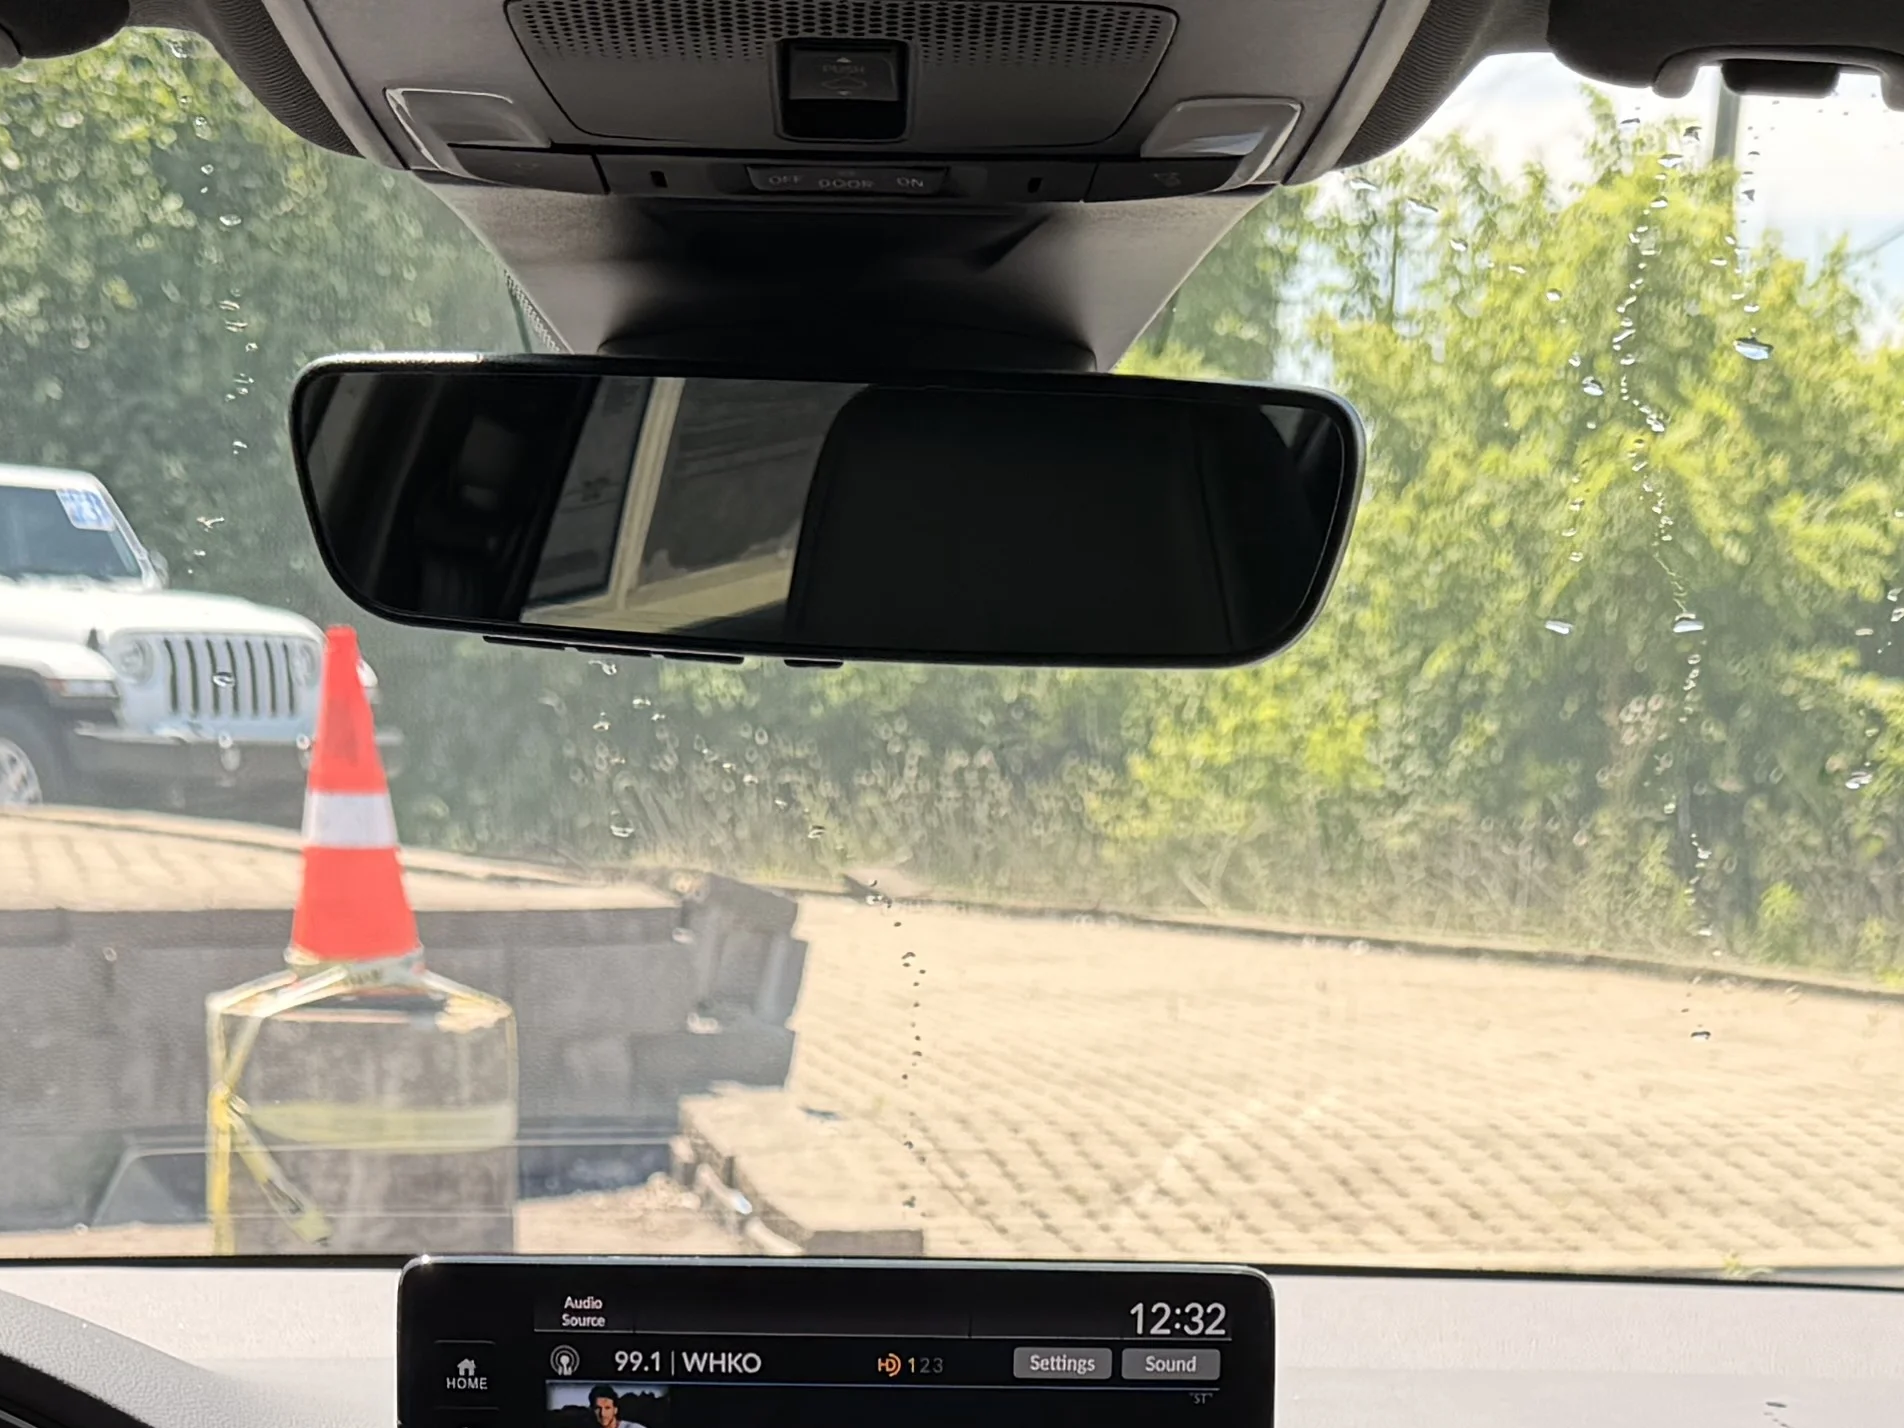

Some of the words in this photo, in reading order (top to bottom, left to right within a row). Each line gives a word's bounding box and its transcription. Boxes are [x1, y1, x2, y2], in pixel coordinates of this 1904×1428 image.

[768, 174, 804, 186] OFF
[817, 177, 876, 190] DOOR
[896, 176, 925, 189] ON
[564, 1296, 603, 1310] Audio
[561, 1313, 606, 1328] Source
[1130, 1302, 1227, 1336] 12:32
[614, 1351, 662, 1372] 99.1
[682, 1351, 762, 1374] WHKO
[1029, 1353, 1096, 1375] Settings
[1145, 1355, 1197, 1372] Sound
[446, 1377, 488, 1390] HOME
